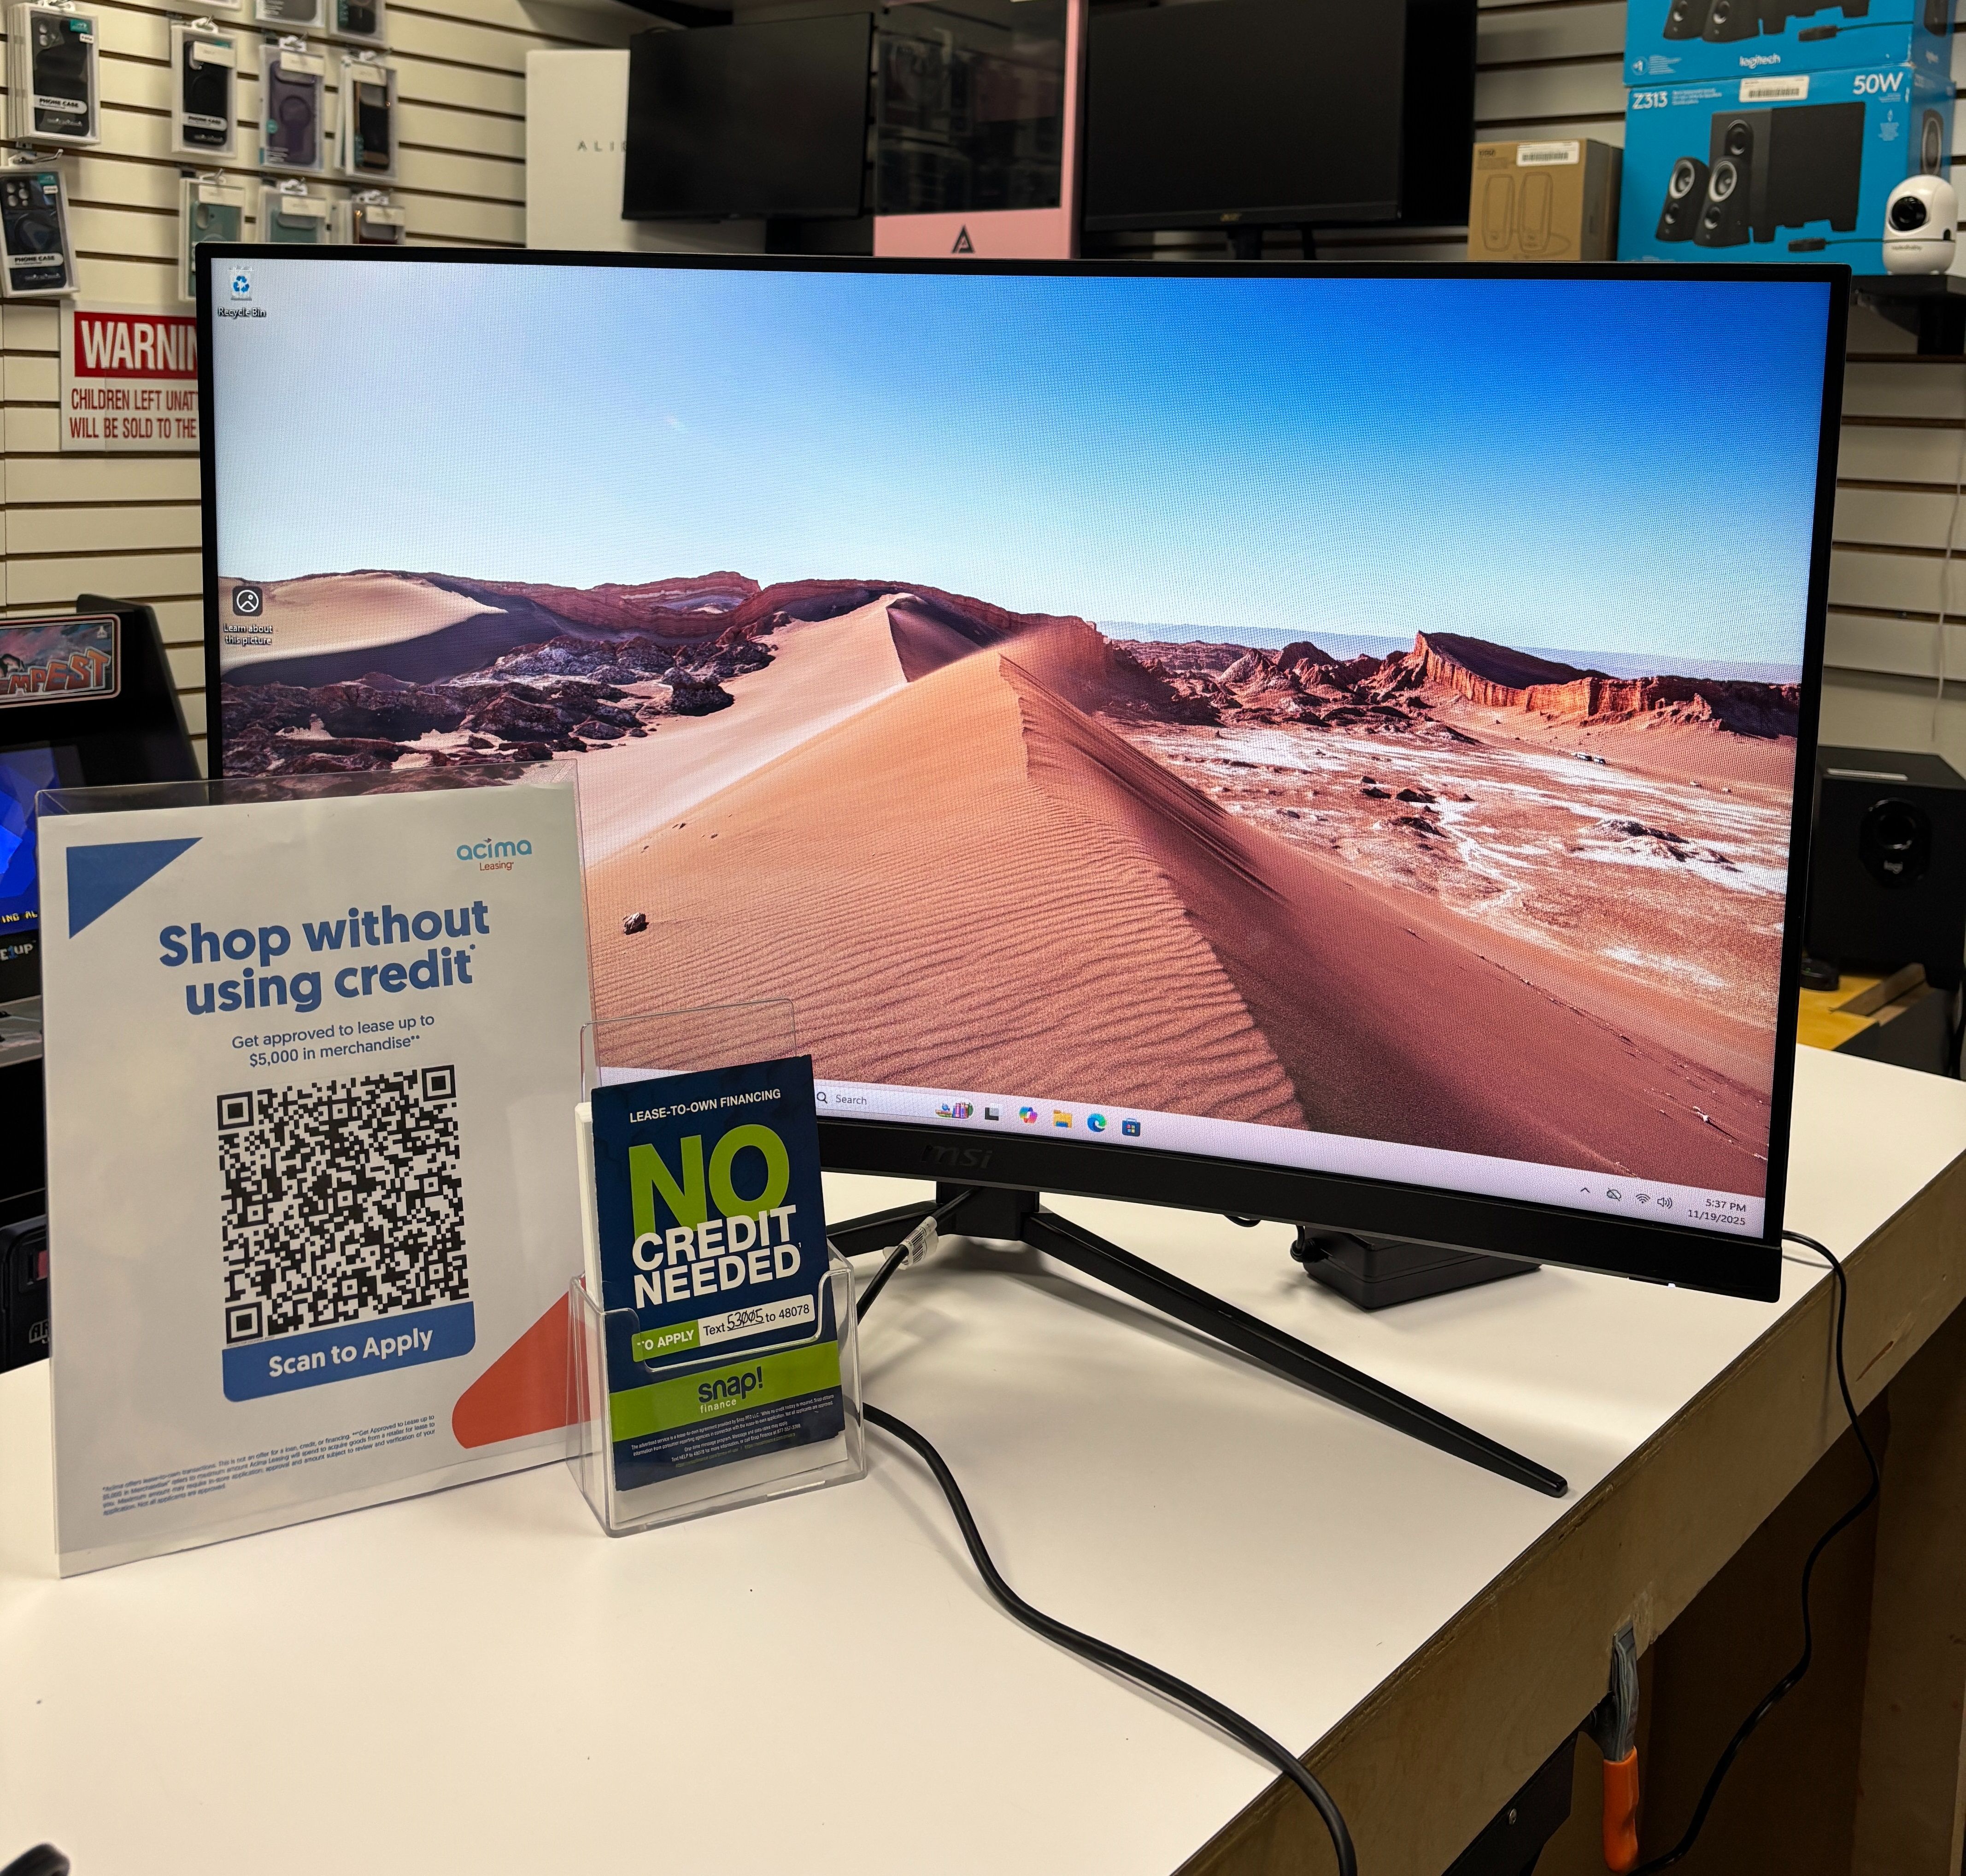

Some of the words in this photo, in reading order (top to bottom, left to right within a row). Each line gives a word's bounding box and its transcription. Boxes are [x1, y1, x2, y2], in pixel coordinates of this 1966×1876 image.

[1739, 53, 1781, 69] logitech
[1853, 71, 1903, 95] 50W
[1632, 91, 1668, 110] Z313
[218, 307, 251, 318] Recycle
[252, 307, 266, 317] Bin
[71, 388, 130, 410] CHILDREN
[135, 390, 162, 410] LEFT
[166, 390, 199, 411] UNAT
[70, 417, 99, 438] WILL
[104, 418, 118, 438] BE
[123, 418, 153, 438] SOLD
[157, 418, 171, 438] TO
[176, 418, 196, 438] THE
[224, 623, 246, 632] Learn
[248, 624, 273, 633] about
[225, 635, 240, 643] this
[242, 636, 272, 646] picture
[457, 838, 532, 860] acima
[159, 920, 291, 967] Shop
[302, 900, 489, 953] without
[185, 968, 321, 1015] using
[232, 1035, 259, 1049] Get
[264, 1025, 335, 1047] approved
[339, 1024, 354, 1036] to
[358, 1020, 394, 1034] lease
[399, 1017, 417, 1031] up
[420, 1015, 434, 1027] to
[249, 1048, 299, 1068] $5,000
[303, 1047, 315, 1060] in
[629, 1099, 717, 1123] LEASE-TO-OWN
[720, 1088, 781, 1108] FINANCING
[836, 1094, 867, 1106] Search
[628, 1124, 790, 1242] NO
[1705, 1199, 1726, 1209] 5:37
[1730, 1202, 1746, 1212] PM
[1688, 1210, 1746, 1226] 11/19/2025
[632, 1205, 797, 1271] CREDIT
[703, 1323, 725, 1336] Text
[765, 1313, 776, 1323] to
[779, 1304, 810, 1319] 48078
[657, 1329, 694, 1348] APPLY
[269, 1351, 325, 1377] Scan
[331, 1346, 357, 1364] to
[363, 1328, 433, 1360] Apply
[698, 1366, 763, 1403] snap!
[700, 1399, 737, 1414] finance
[370, 1423, 396, 1434] Approved
[349, 1438, 366, 1447] goods
[355, 1444, 373, 1452] review
